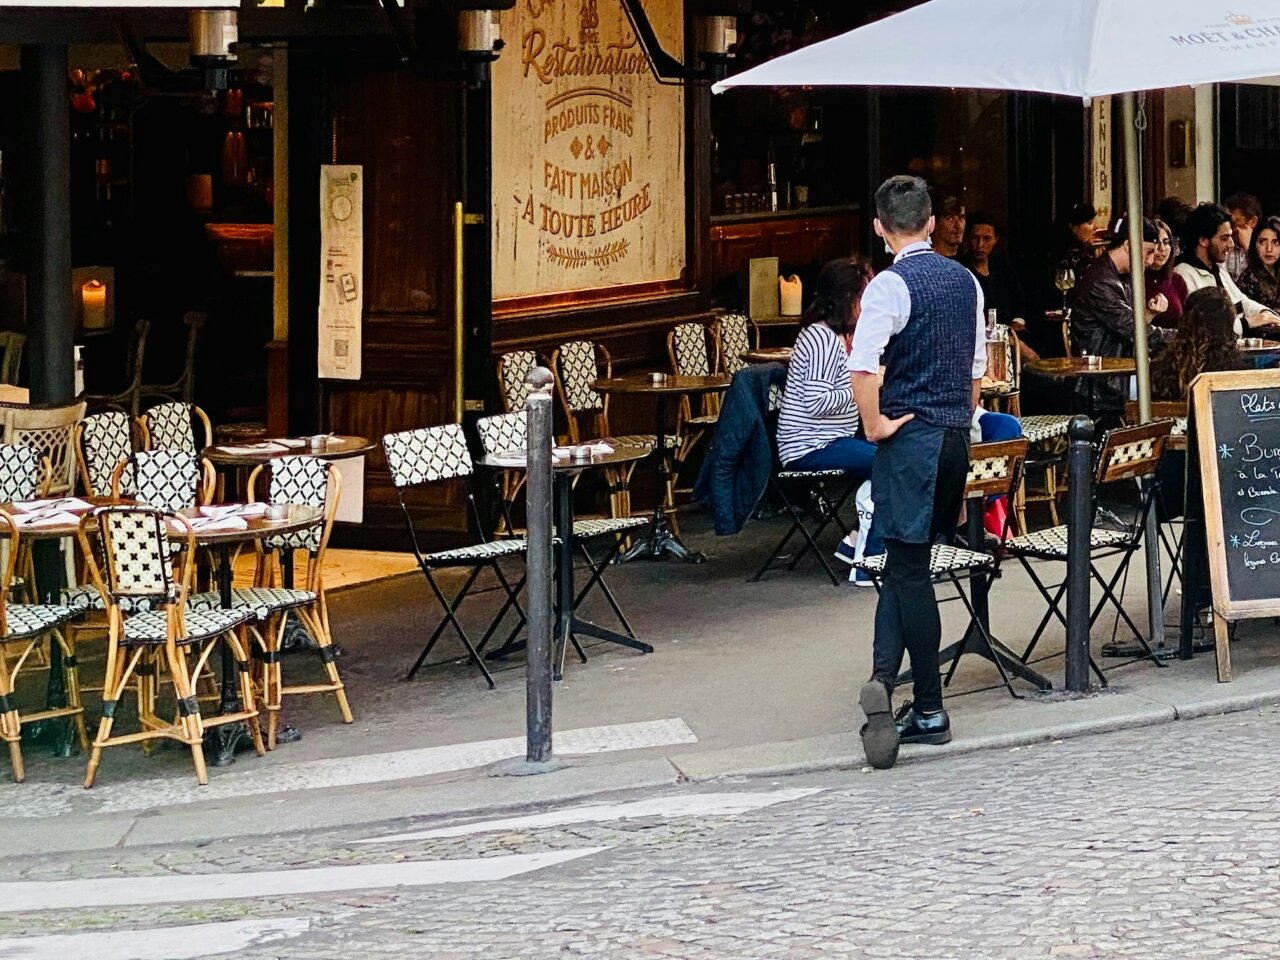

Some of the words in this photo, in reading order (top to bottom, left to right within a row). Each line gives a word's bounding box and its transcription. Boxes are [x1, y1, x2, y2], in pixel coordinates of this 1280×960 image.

[522, 27, 650, 85] Restauration
[543, 102, 600, 143] PRODUITS
[602, 104, 634, 138] FRAIS
[543, 159, 577, 199] FAIT
[580, 156, 632, 200] MAISON
[539, 202, 596, 239] TOUTE
[600, 182, 652, 234] HEURE
